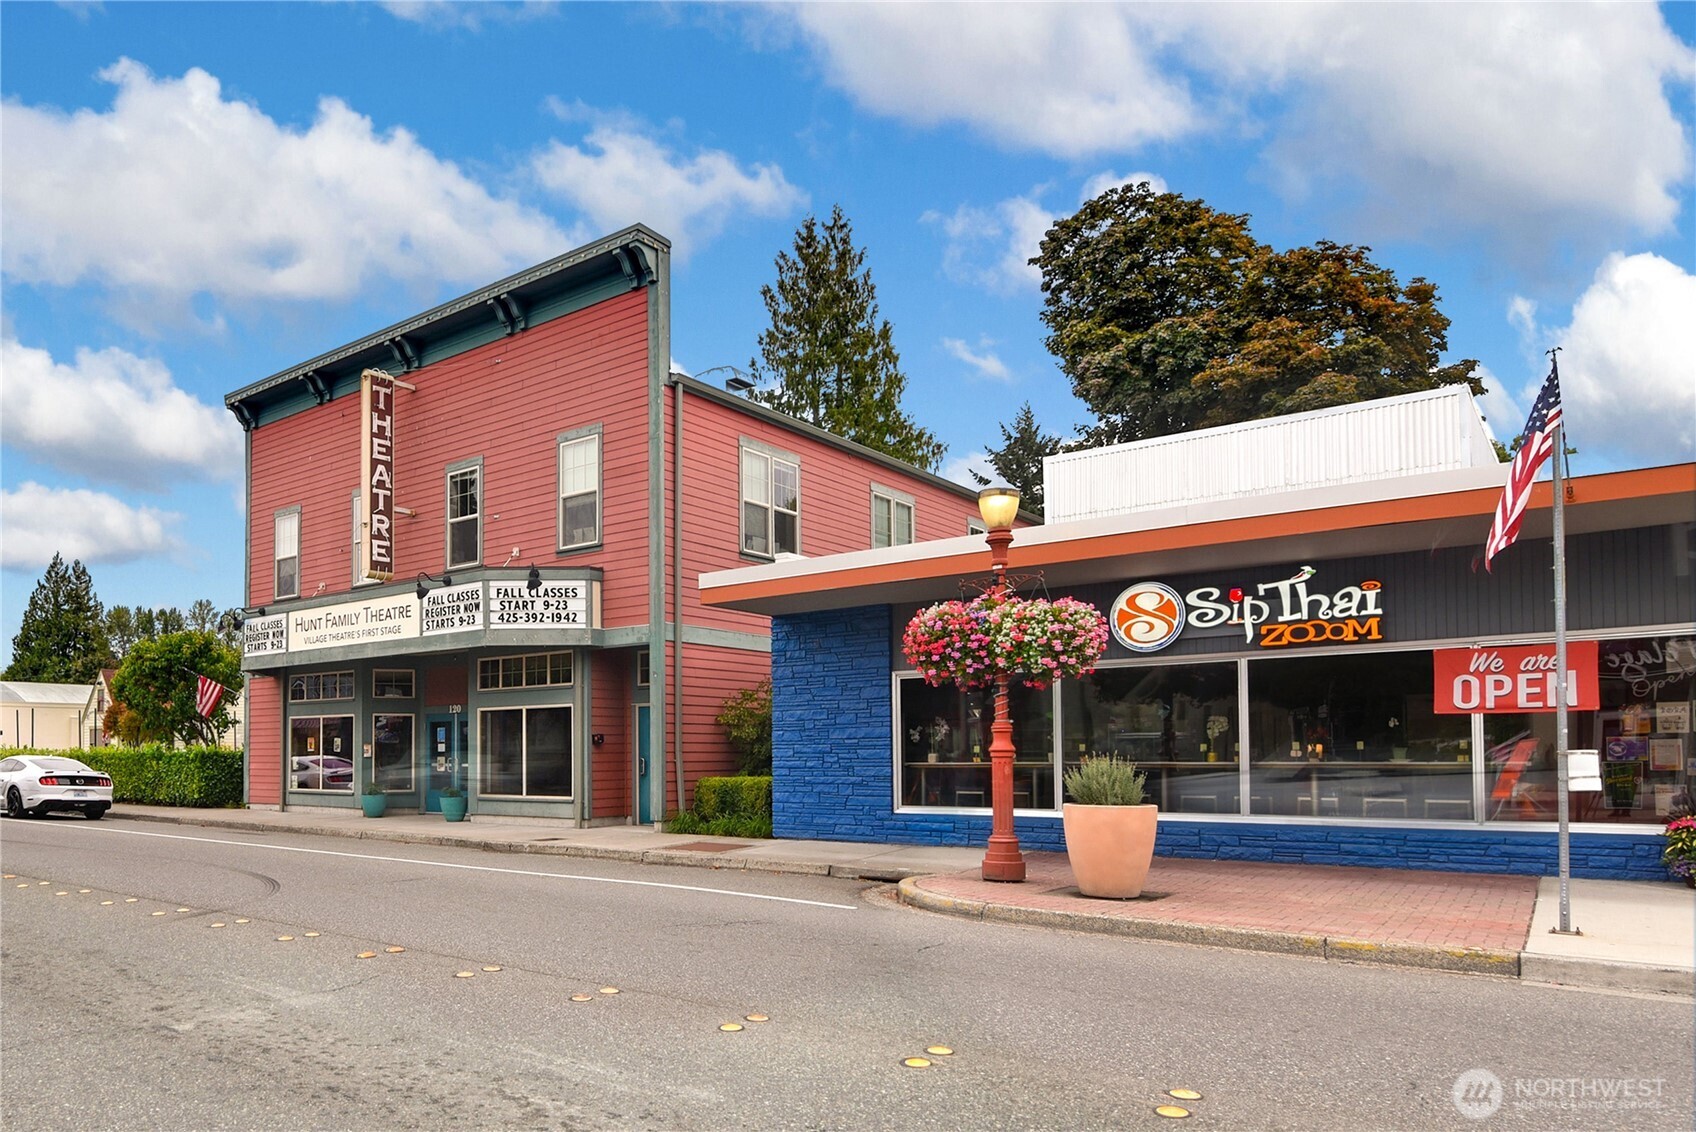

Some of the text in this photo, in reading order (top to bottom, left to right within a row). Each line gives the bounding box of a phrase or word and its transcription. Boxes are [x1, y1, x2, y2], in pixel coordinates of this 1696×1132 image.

[371, 384, 392, 563] THEATRE
[427, 589, 480, 607] FALL CLASSES
[496, 587, 578, 599] FALL CLASSES
[425, 601, 480, 619] REGISTER NOW
[499, 600, 568, 611] START 9-23
[1185, 569, 1383, 644] Sip Thai
[246, 619, 283, 633] FALL CLASSES
[295, 604, 412, 633] HUNT FAMILY THEATRE
[426, 614, 476, 631] STARTS 9-23
[497, 612, 578, 623] 425-392-1942
[245, 629, 284, 643] REGISTER NOW
[303, 624, 402, 645] VILLAGE THEATRE'S FIRST STAGE
[247, 640, 283, 653] STARTS 9-23
[1469, 651, 1558, 673] We are
[1452, 669, 1578, 710] OPEN
[448, 704, 462, 714] 120
